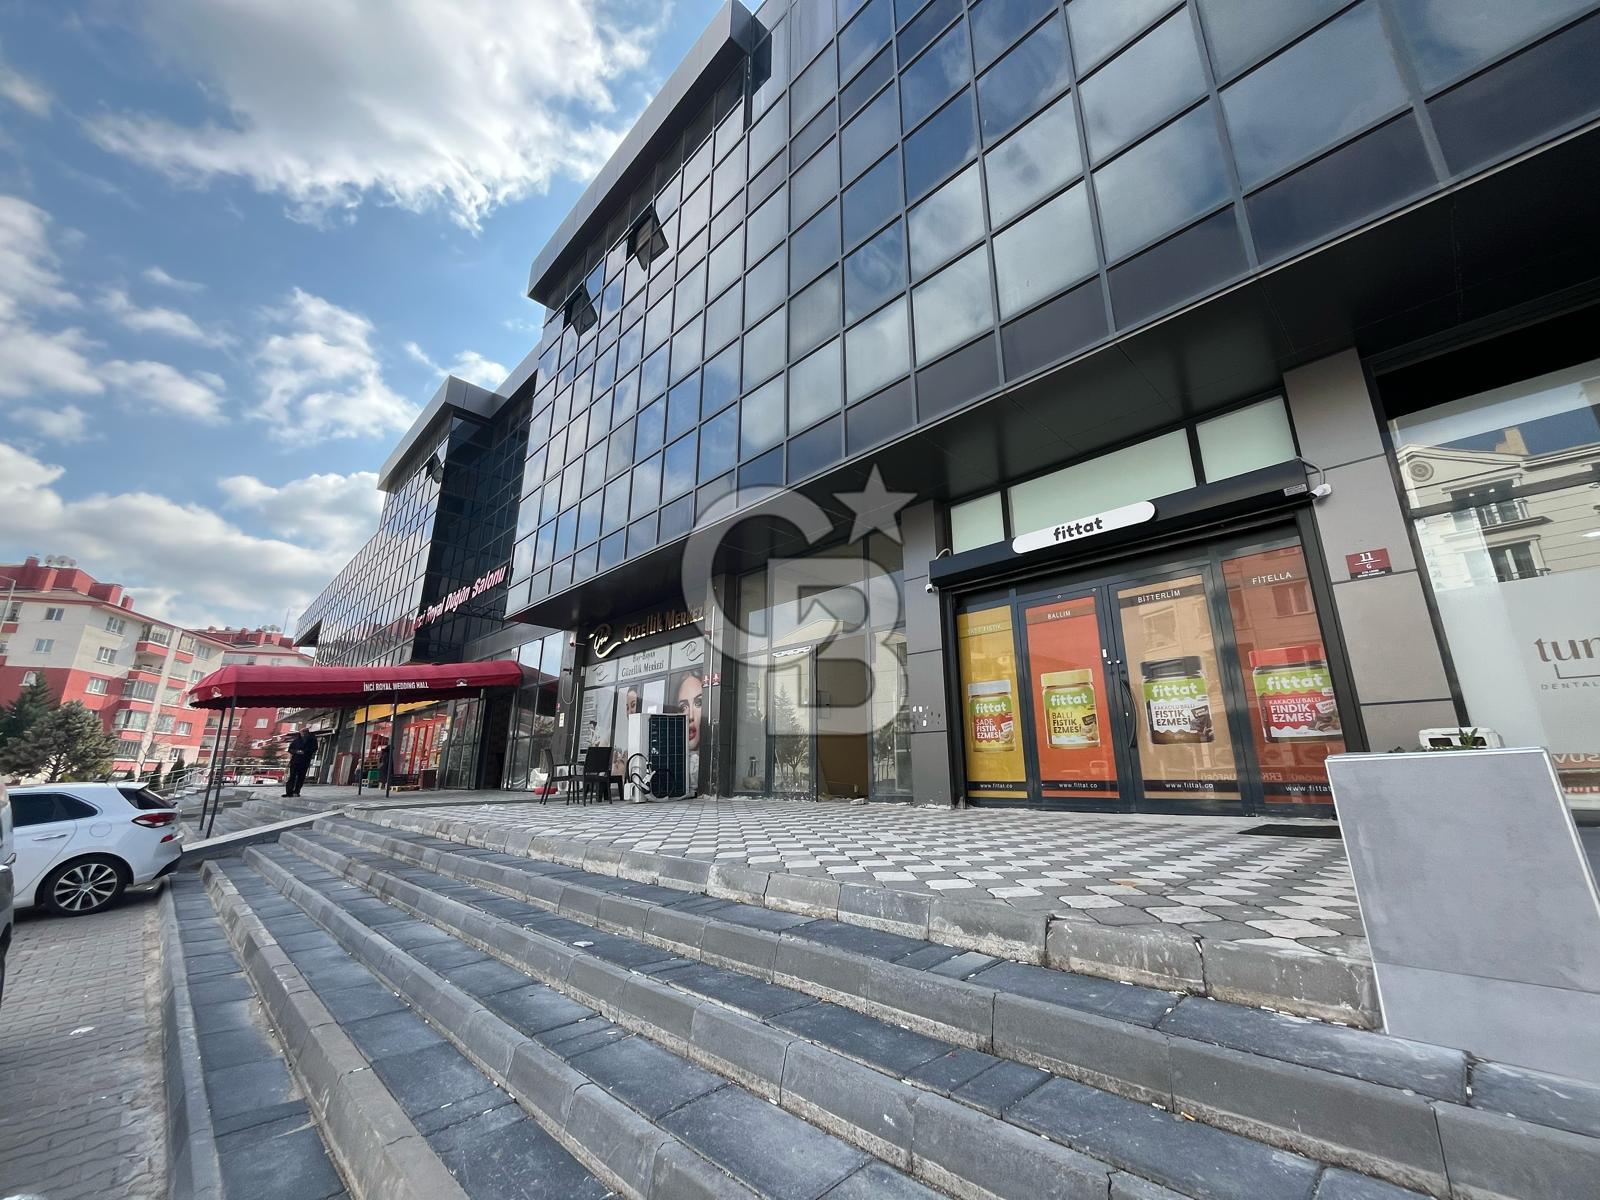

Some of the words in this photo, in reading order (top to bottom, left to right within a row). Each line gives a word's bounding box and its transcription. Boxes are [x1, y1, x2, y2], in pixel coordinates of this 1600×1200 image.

[1053, 517, 1104, 541] fittat
[1359, 552, 1374, 562] 11
[471, 566, 507, 598] Salonu
[375, 682, 392, 691] ROYAL
[392, 681, 416, 690] WEDDING
[416, 681, 430, 689] HALL
[1266, 673, 1323, 691] fittat
[1541, 681, 1600, 690] DENTAL
[1152, 682, 1198, 698] fittat
[1050, 693, 1088, 706] fittat
[975, 701, 1007, 713] fittat
[1270, 703, 1311, 714] FINDIK
[1155, 709, 1185, 718] FISTIK
[1272, 709, 1316, 723] EZMESİ
[976, 718, 994, 726] SADE
[1052, 718, 1077, 726] FISTIK
[1156, 715, 1191, 726] EZMESİ
[1058, 781, 1098, 789] www.fittat.co
[1164, 781, 1214, 789] www.fittat.co
